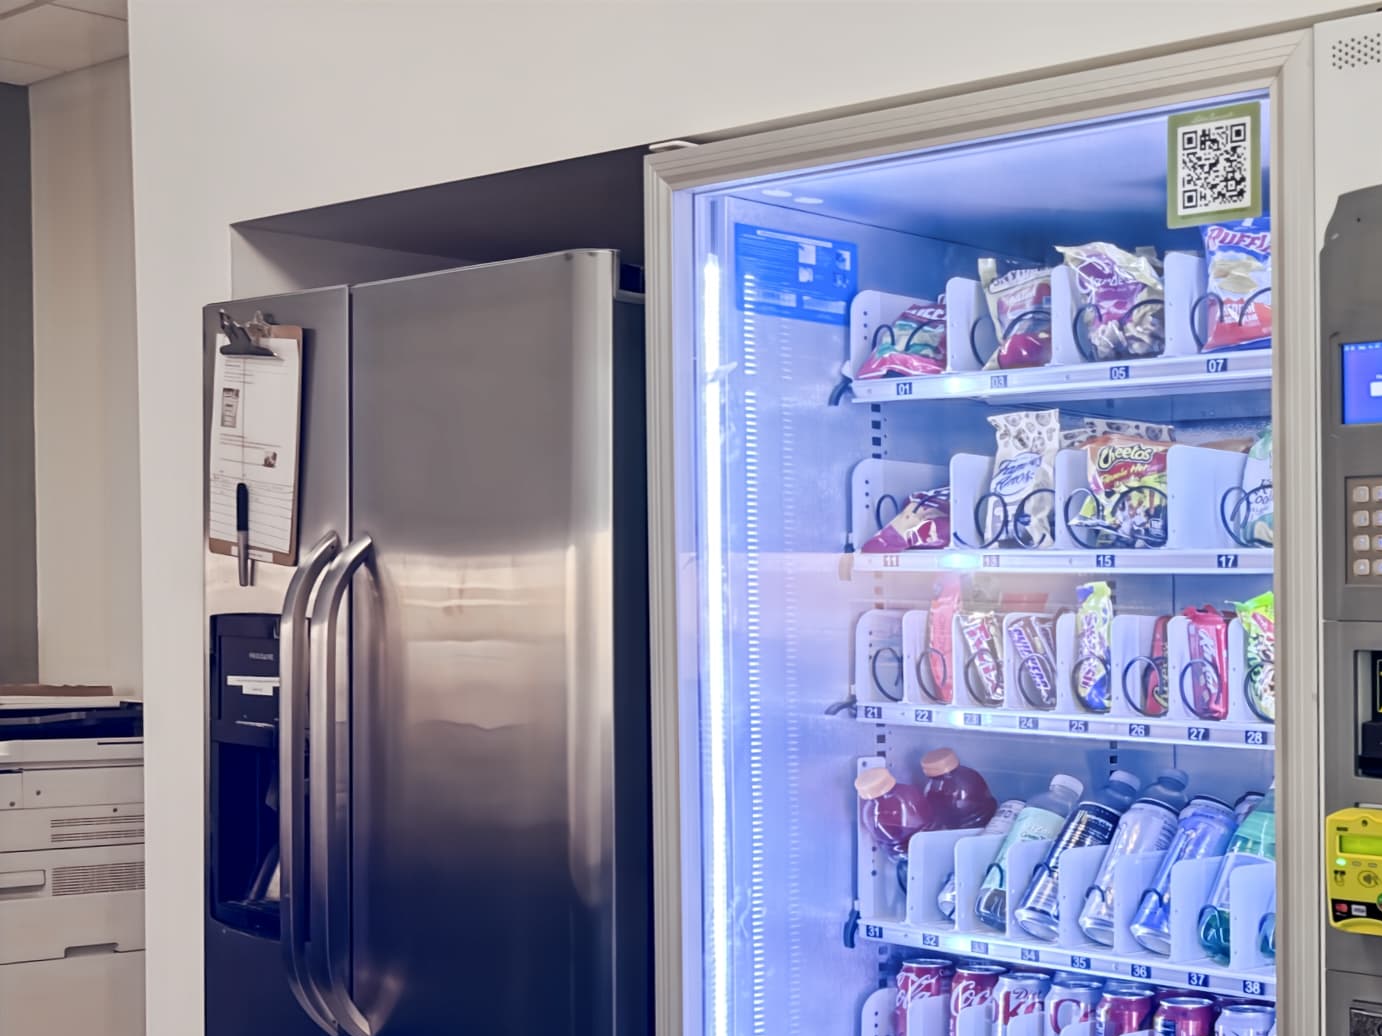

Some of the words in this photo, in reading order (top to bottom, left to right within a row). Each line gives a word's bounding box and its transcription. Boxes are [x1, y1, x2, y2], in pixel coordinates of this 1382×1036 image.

[1208, 226, 1271, 252] RUFFL
[1209, 360, 1224, 372] 07
[1112, 368, 1126, 379] 05
[898, 384, 910, 395] 01
[1097, 445, 1153, 470] Cheetos
[1098, 556, 1112, 567] 15
[1219, 556, 1234, 568] 17
[866, 707, 879, 718] 21
[916, 710, 929, 721] 22
[1021, 718, 1033, 729] 24
[1071, 721, 1085, 732] 25
[1131, 725, 1145, 736] 26
[1190, 728, 1205, 740] 27
[1247, 732, 1262, 744] 28
[868, 926, 880, 937] 31
[924, 934, 936, 946] 32
[1023, 949, 1036, 960] 34
[1073, 956, 1087, 968] 35
[1133, 965, 1147, 977] 36
[1190, 973, 1205, 985] 37
[1245, 981, 1260, 994] 38
